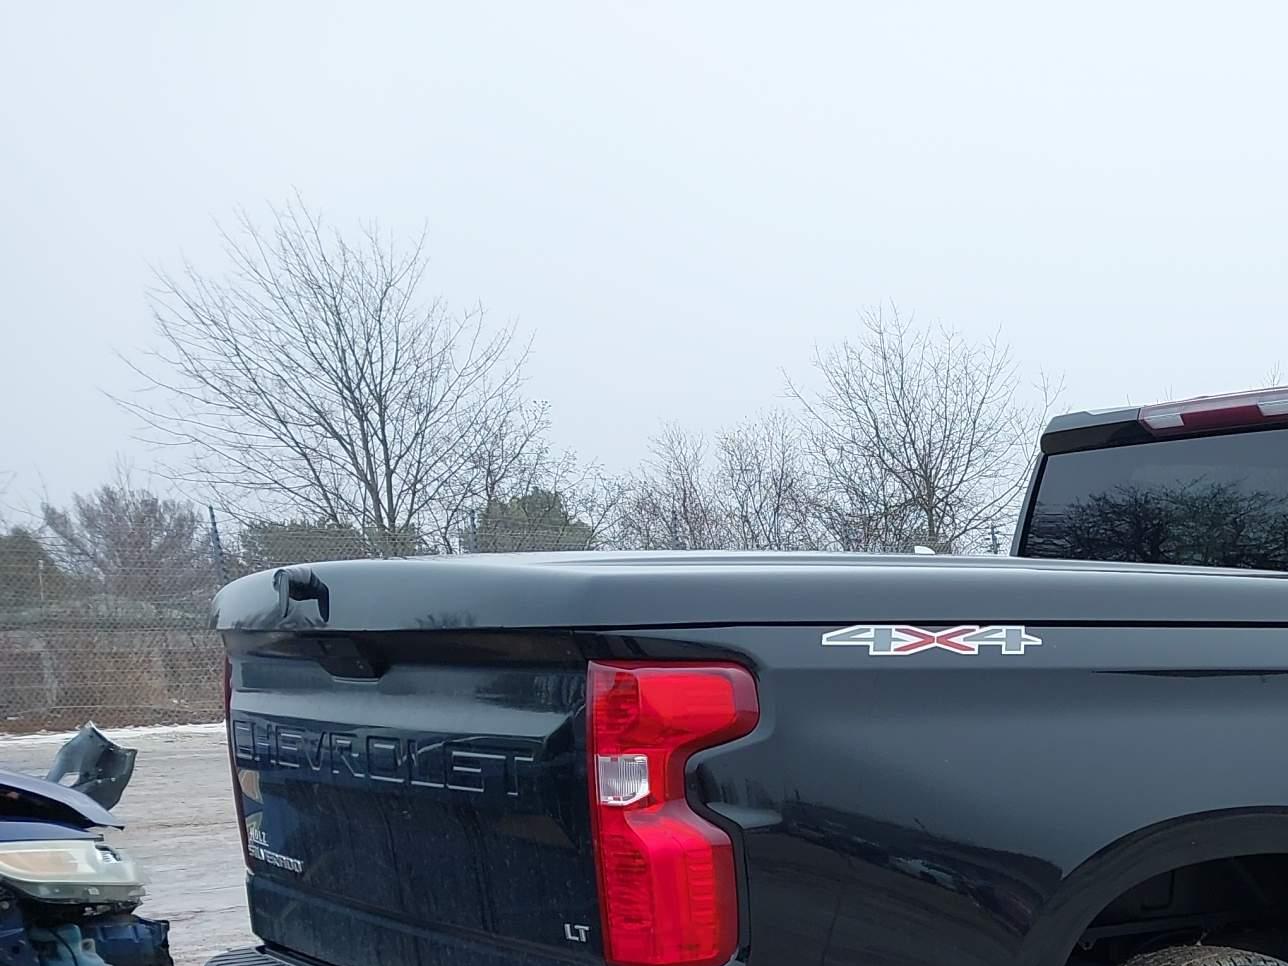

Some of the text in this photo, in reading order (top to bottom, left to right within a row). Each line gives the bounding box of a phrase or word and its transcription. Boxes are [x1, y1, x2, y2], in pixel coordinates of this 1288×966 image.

[233, 719, 535, 797] CHEVROLET
[247, 844, 304, 873] SILVERADO
[564, 923, 590, 943] LT
